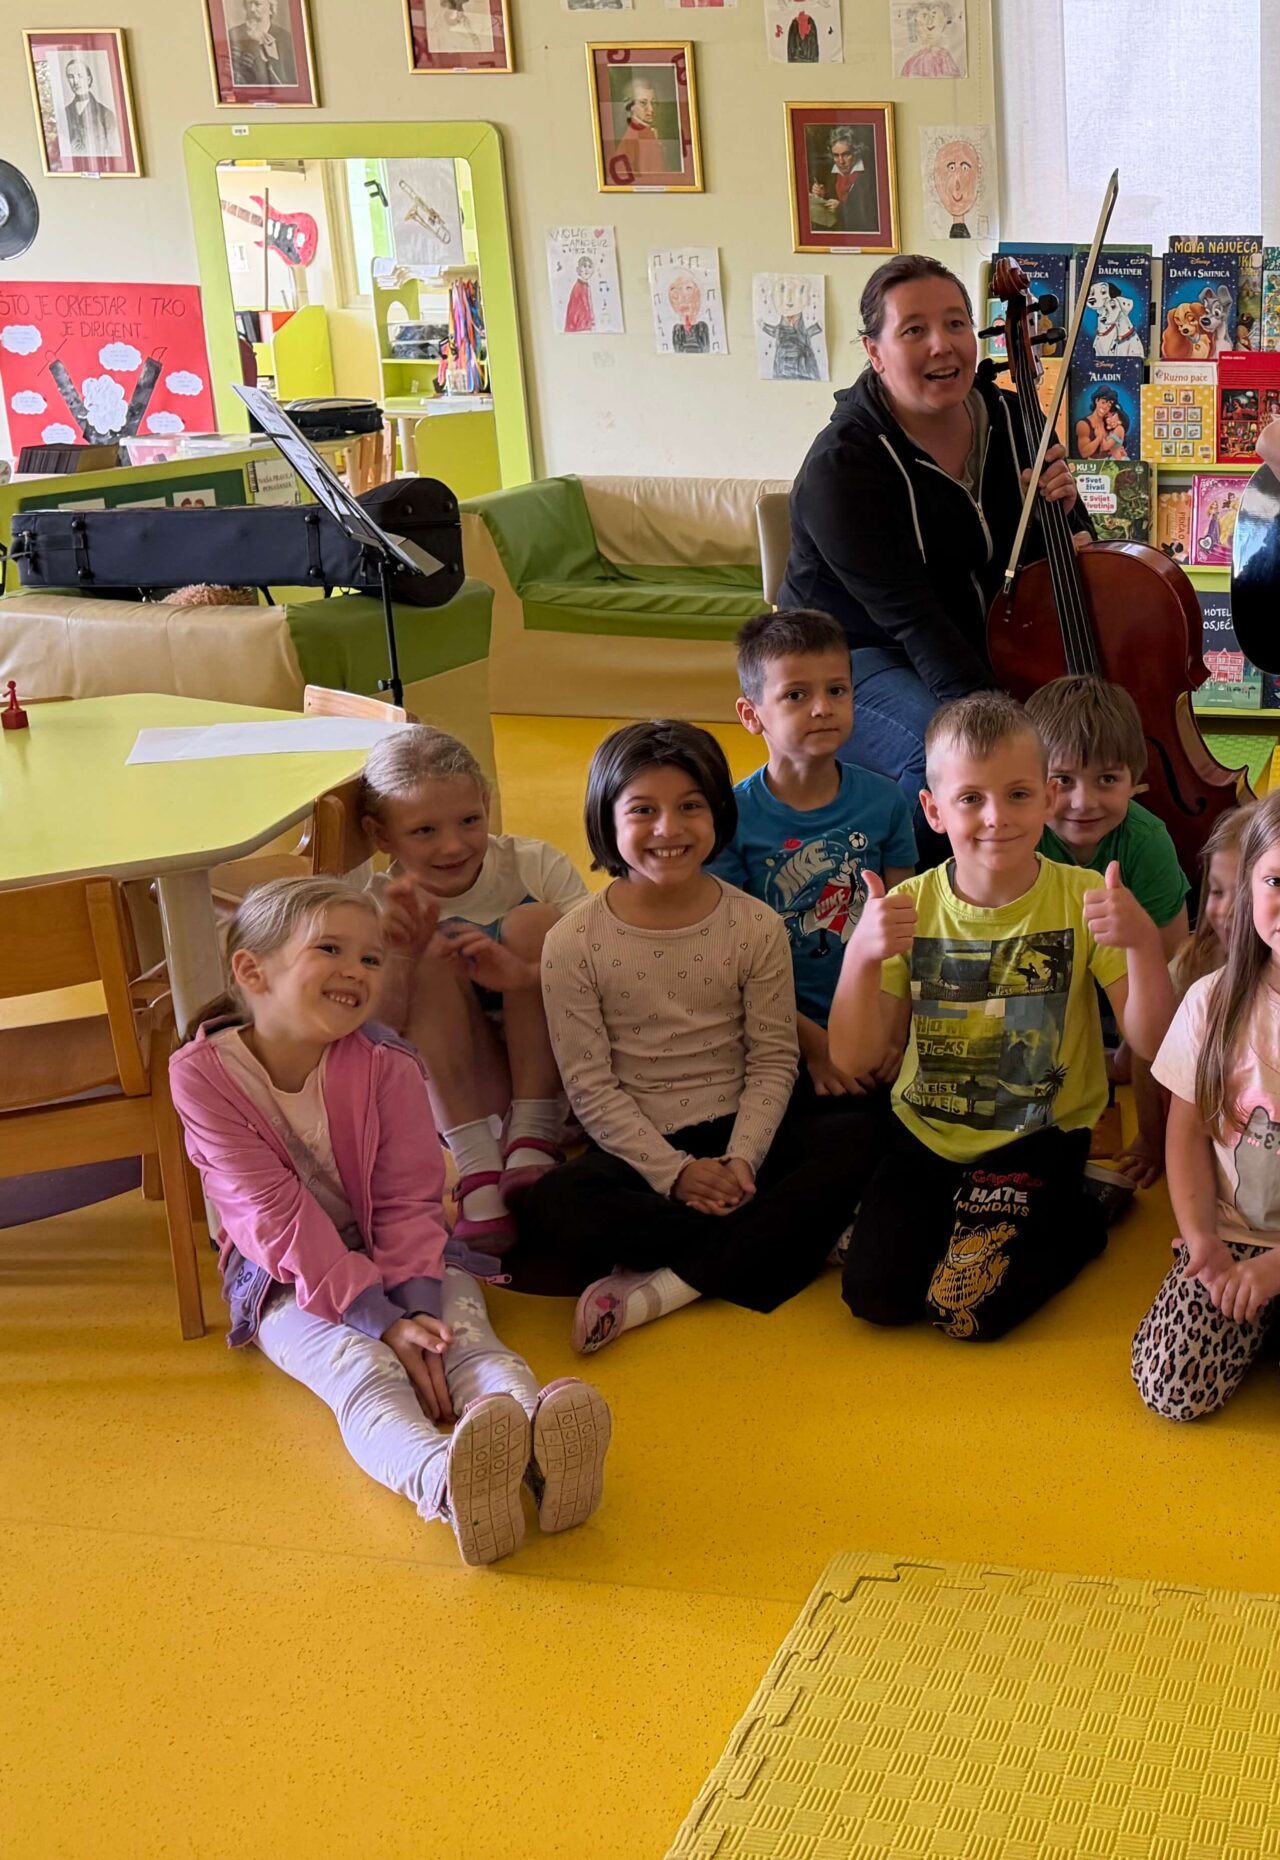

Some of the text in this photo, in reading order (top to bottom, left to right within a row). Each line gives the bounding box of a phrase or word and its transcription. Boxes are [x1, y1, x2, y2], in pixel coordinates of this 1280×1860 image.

[1208, 238, 1259, 253] NAJVEĆA
[34, 295, 53, 321] JE
[55, 294, 127, 317] ORKESTAR
[153, 297, 186, 317] TKO
[60, 321, 74, 337] JE
[1090, 372, 1121, 382] ALADIN
[1087, 503, 1115, 511] ivotinja
[1203, 608, 1232, 617] HOTEL
[1202, 618, 1234, 631] OSJEĆ
[773, 839, 836, 908] NIKE
[969, 1186, 1028, 1204] HATE
[956, 1200, 1030, 1217] MONDAYS
